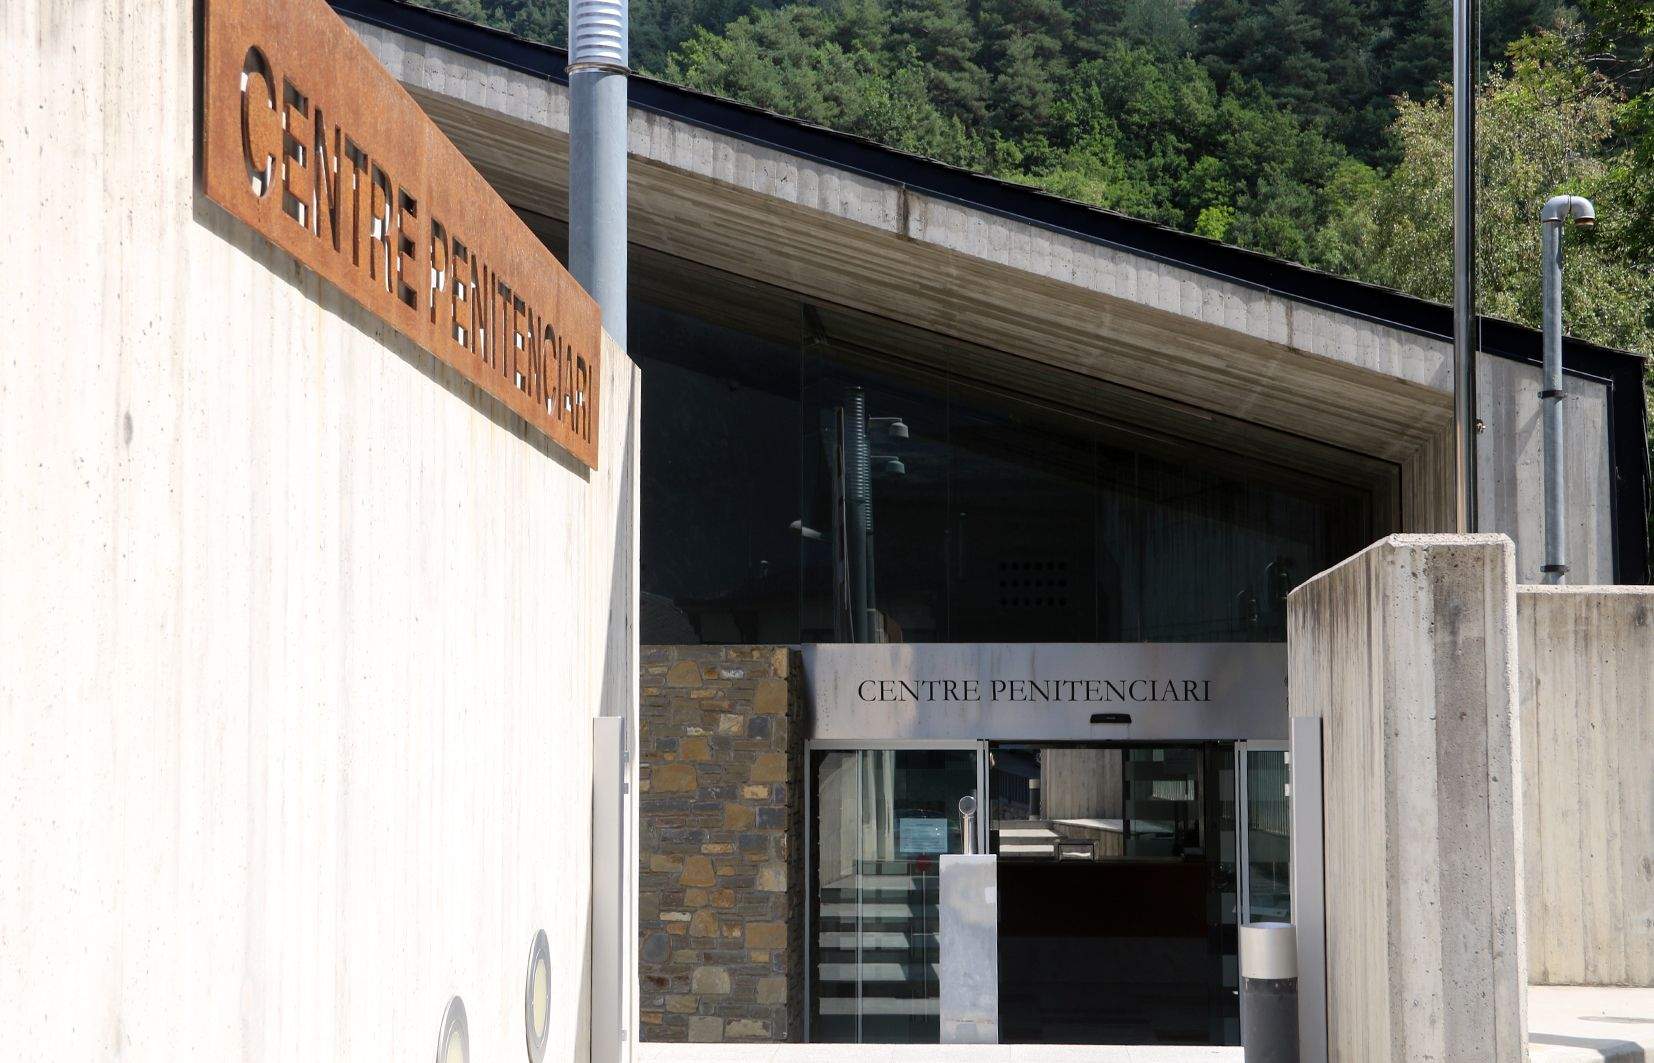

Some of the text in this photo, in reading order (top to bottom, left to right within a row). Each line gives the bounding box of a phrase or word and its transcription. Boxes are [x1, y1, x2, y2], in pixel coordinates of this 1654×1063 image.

[240, 45, 592, 444] CENTRE PENITENCIARI
[858, 679, 1212, 702] CENTRE PENITENCIARI
